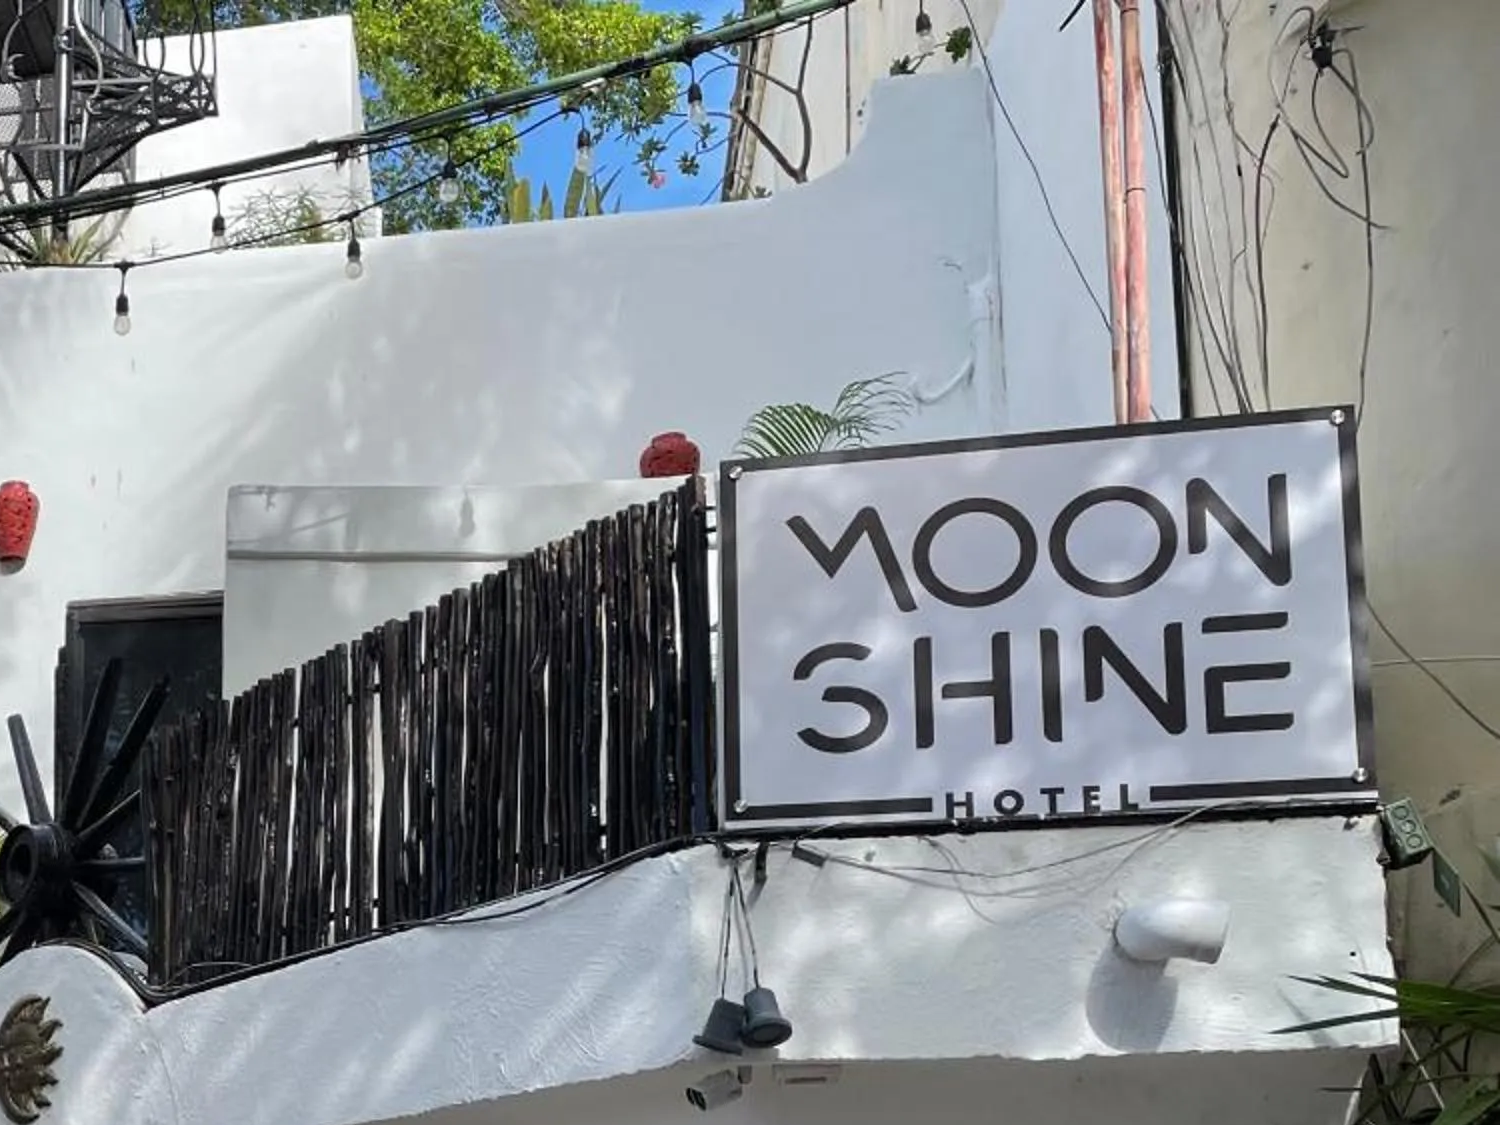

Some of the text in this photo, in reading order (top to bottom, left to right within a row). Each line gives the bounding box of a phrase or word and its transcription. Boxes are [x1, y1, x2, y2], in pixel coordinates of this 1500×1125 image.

[785, 472, 1292, 613] MOON
[793, 611, 1295, 754] SHINE
[945, 783, 1139, 819] HOTEL
